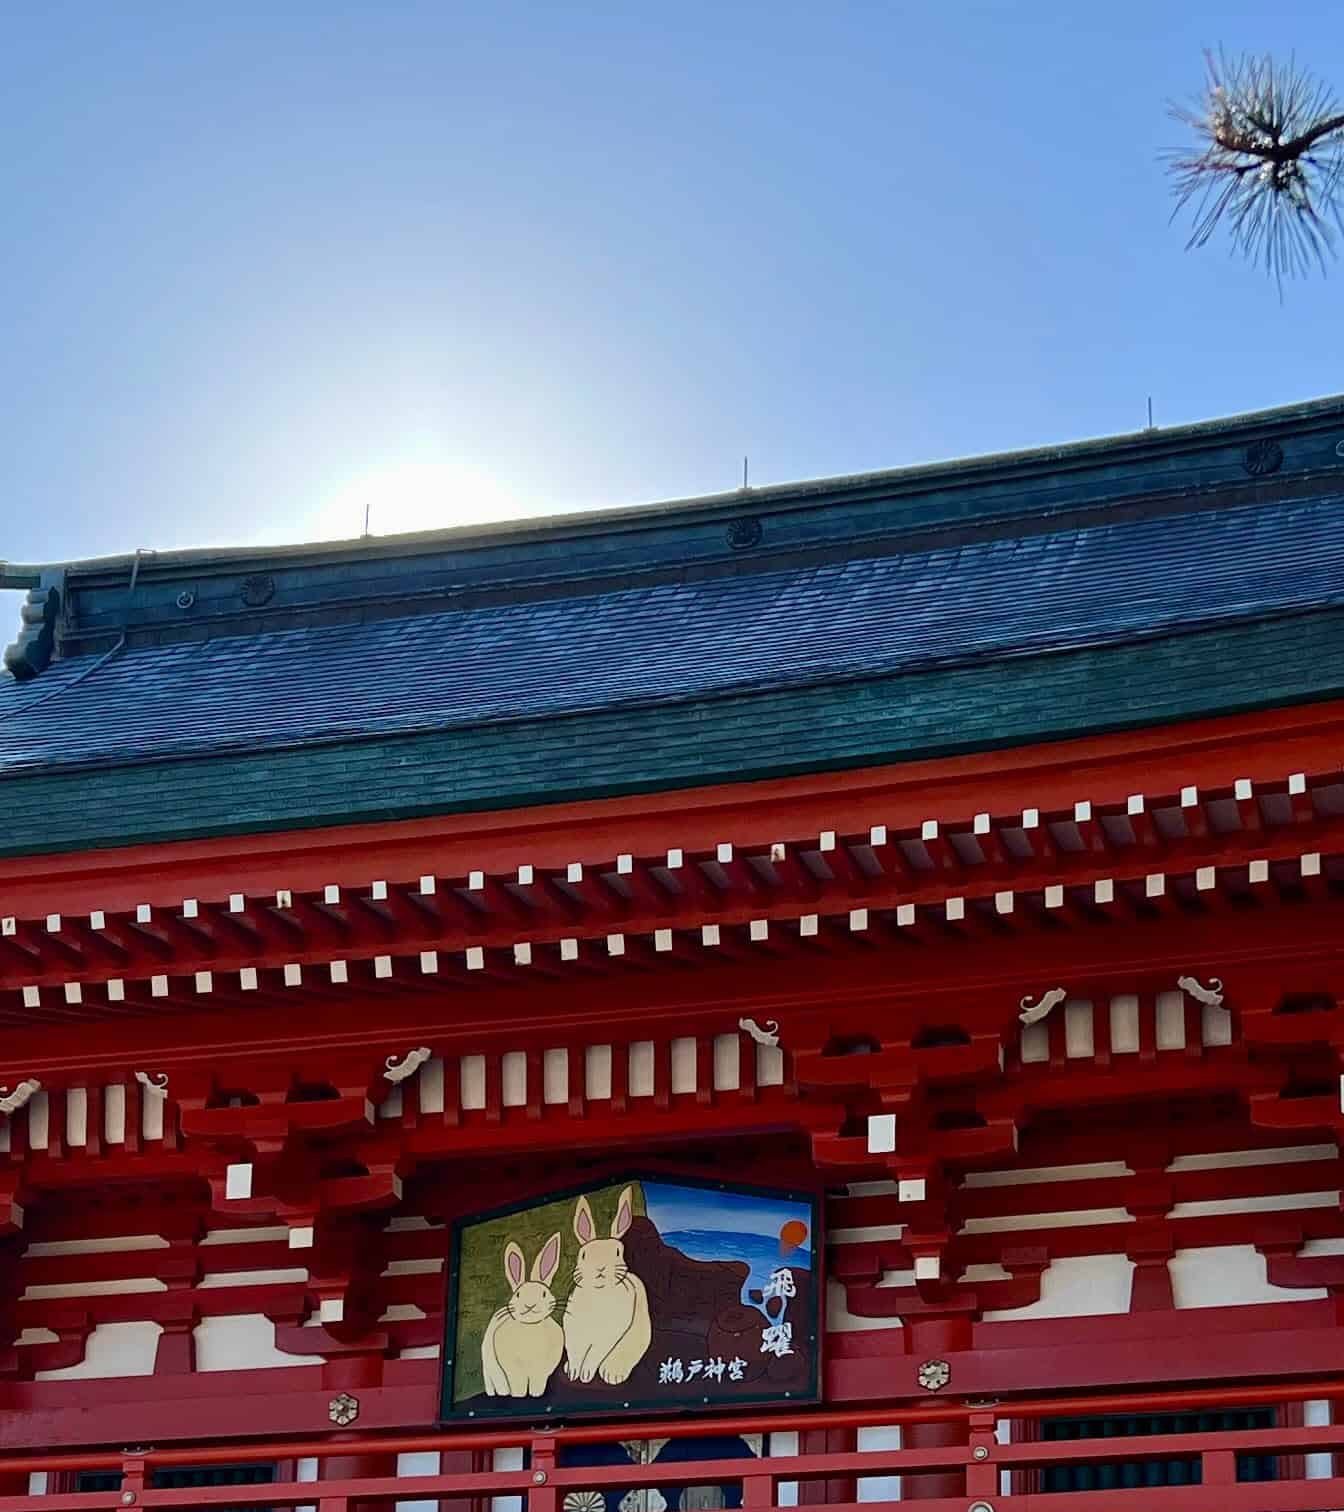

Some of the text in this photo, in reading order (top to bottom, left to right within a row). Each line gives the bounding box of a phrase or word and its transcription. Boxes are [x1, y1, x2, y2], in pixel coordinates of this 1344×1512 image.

[760, 1268, 797, 1358] 飛躍
[659, 1357, 748, 1384] 鵜戸神宮
